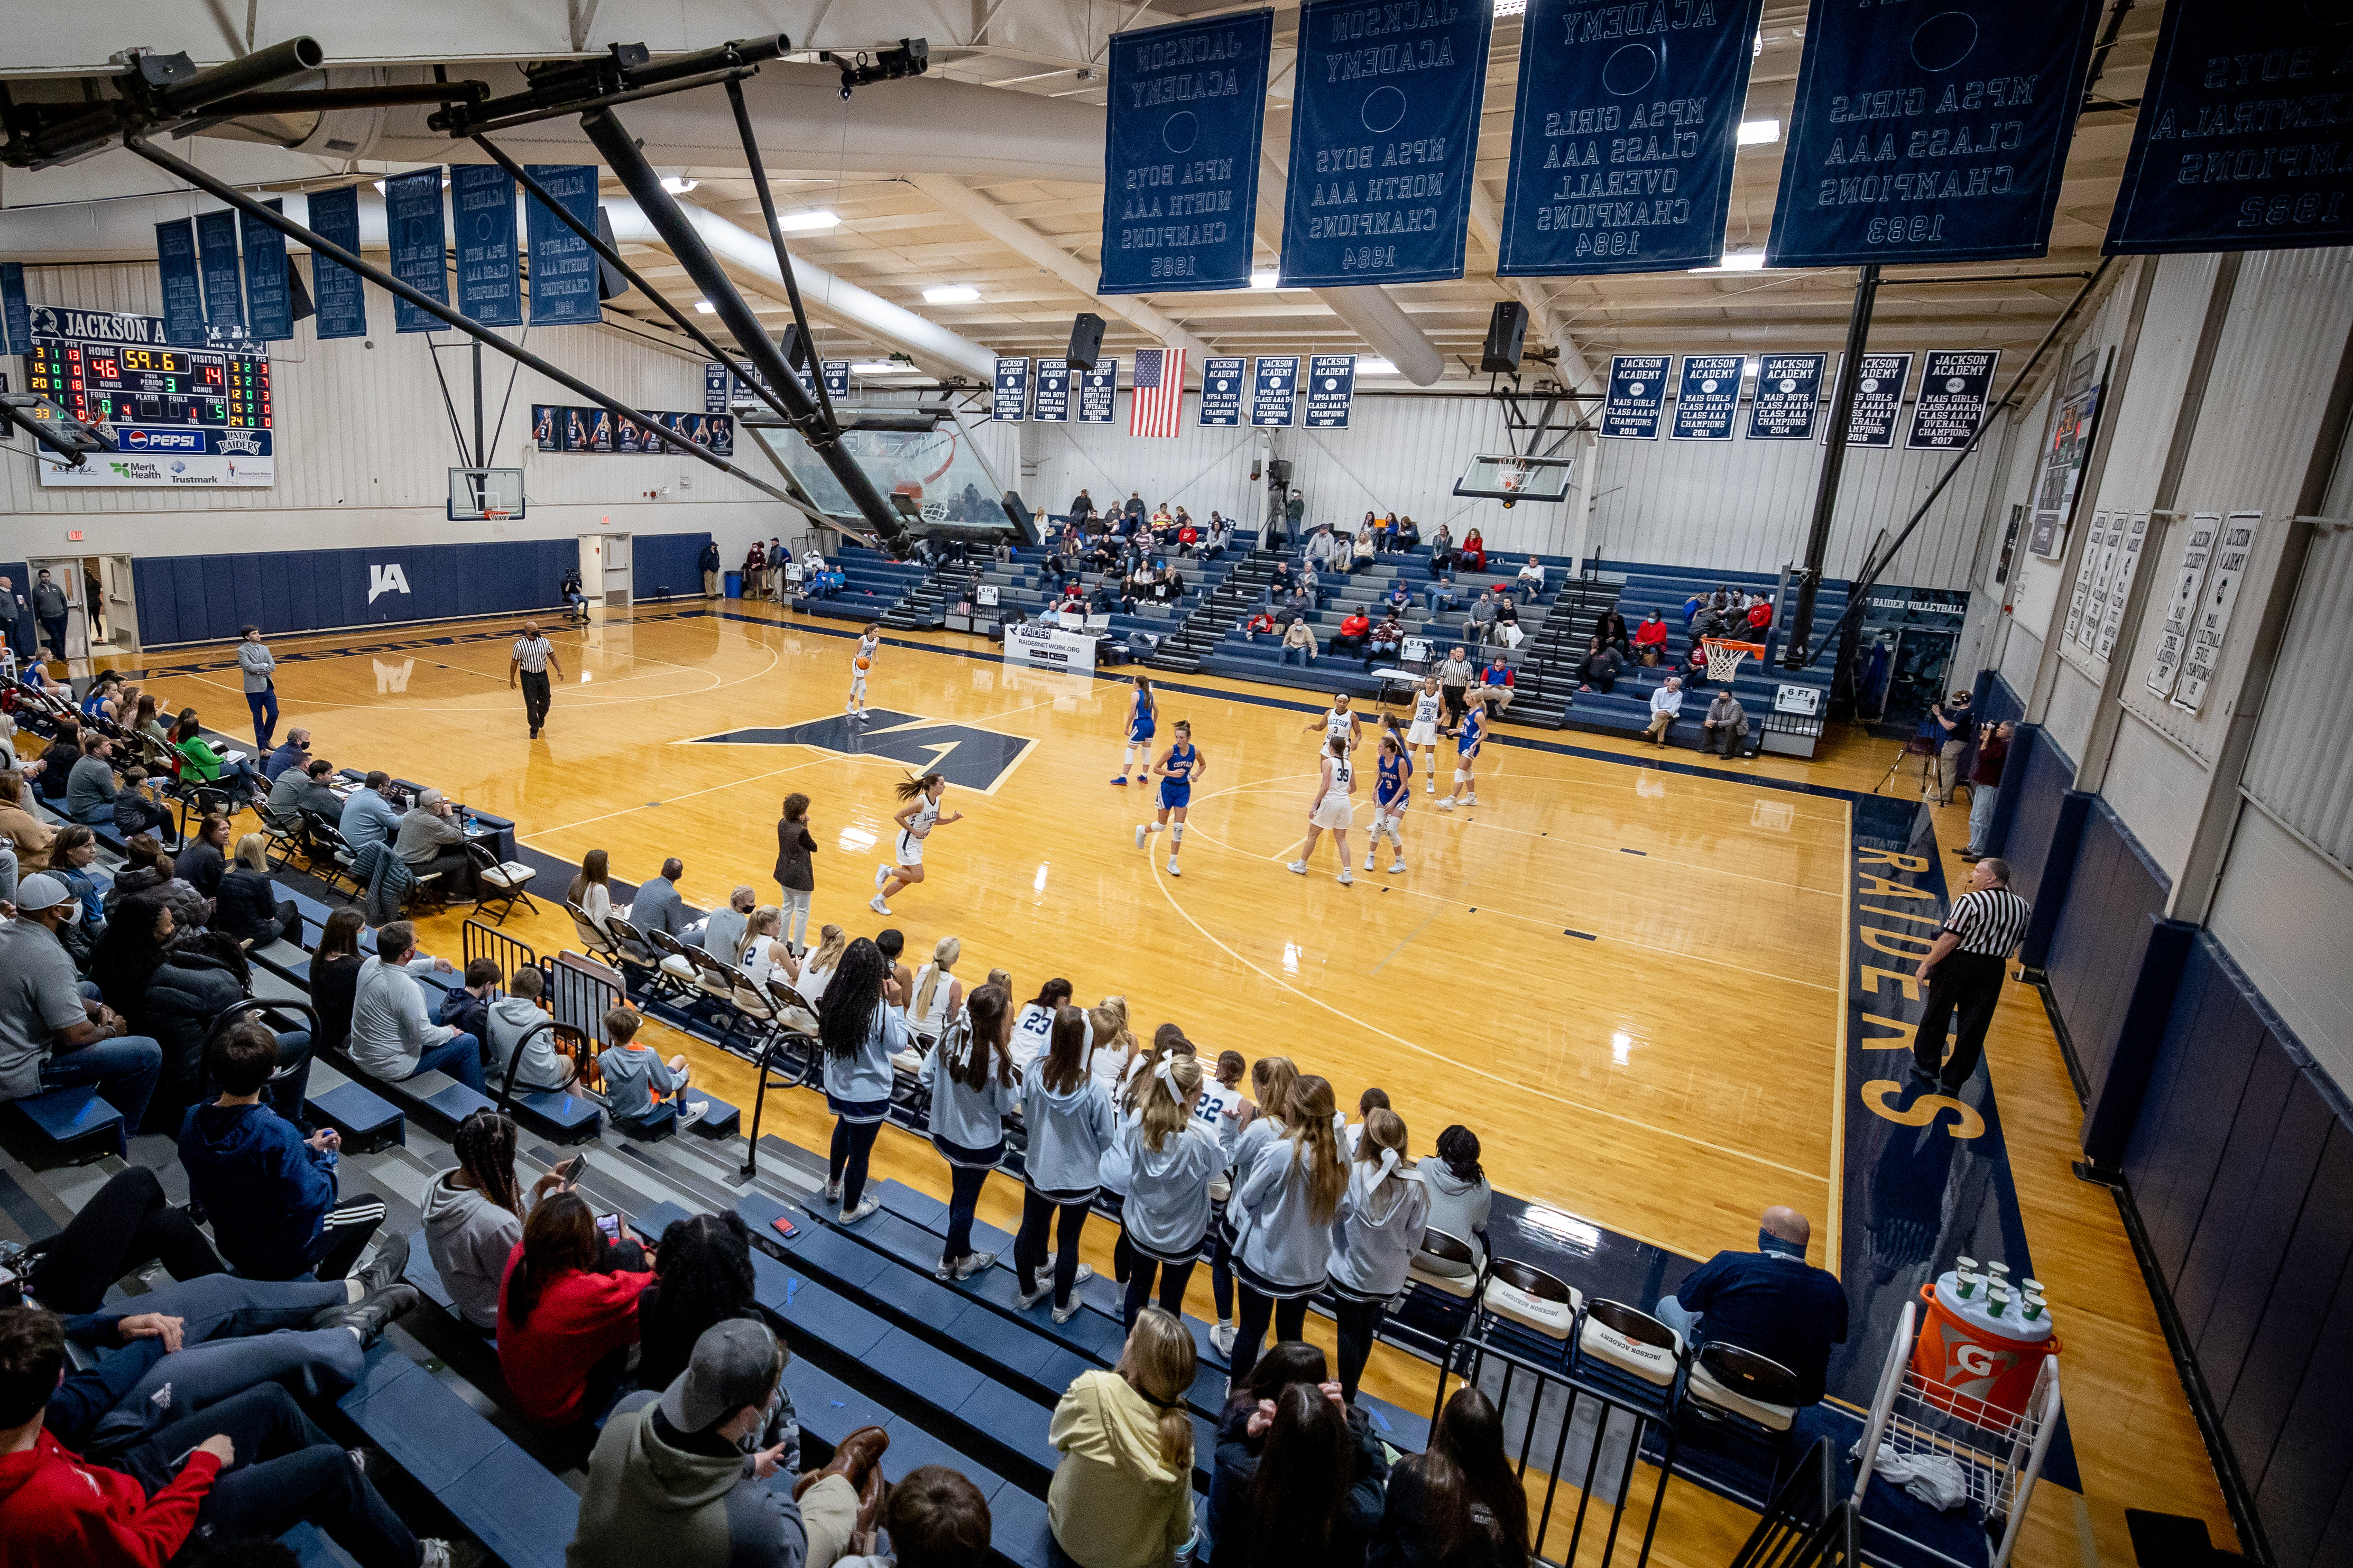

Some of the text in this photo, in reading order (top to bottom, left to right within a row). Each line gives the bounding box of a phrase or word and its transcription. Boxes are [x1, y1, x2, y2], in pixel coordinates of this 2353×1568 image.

[66, 312, 148, 341] JACKSON
[88, 347, 115, 356] HOME
[126, 350, 174, 370] 59.6
[191, 355, 223, 364] VISITOR
[1621, 359, 1663, 368] JACKSON
[1692, 359, 1737, 368] JACKSON
[1769, 359, 1815, 369] JACKSON
[1935, 355, 1988, 365] JACKSON
[93, 360, 118, 378] 46
[1690, 369, 1735, 379] ACADEMY
[1767, 369, 1814, 378] ACADEMY
[1932, 366, 1986, 375] ACADEMY
[206, 367, 222, 384] 14
[1618, 370, 1661, 379] ACADEMY
[167, 378, 176, 392] 3
[123, 405, 130, 414] 4
[216, 405, 224, 419] 5
[1610, 417, 1651, 426] CHAMPIONS
[227, 431, 250, 440] LADY
[150, 435, 195, 447] PEPSI
[219, 441, 259, 453] RAIDERS
[70, 531, 83, 540] EXIT
[1872, 598, 1904, 608] RAIDER
[1908, 601, 1964, 614] VOLLEYBALL
[1019, 639, 1080, 653] RAIDERNETWORK.ORG
[1328, 719, 1349, 728] JACKSON
[1386, 781, 1392, 789] 3
[1023, 1012, 1051, 1035] 23
[1502, 1290, 1558, 1317] JACKSON ACADEMY
[1600, 1332, 1663, 1361] JACKSON ACADEMY
[1957, 1344, 1995, 1376] G
